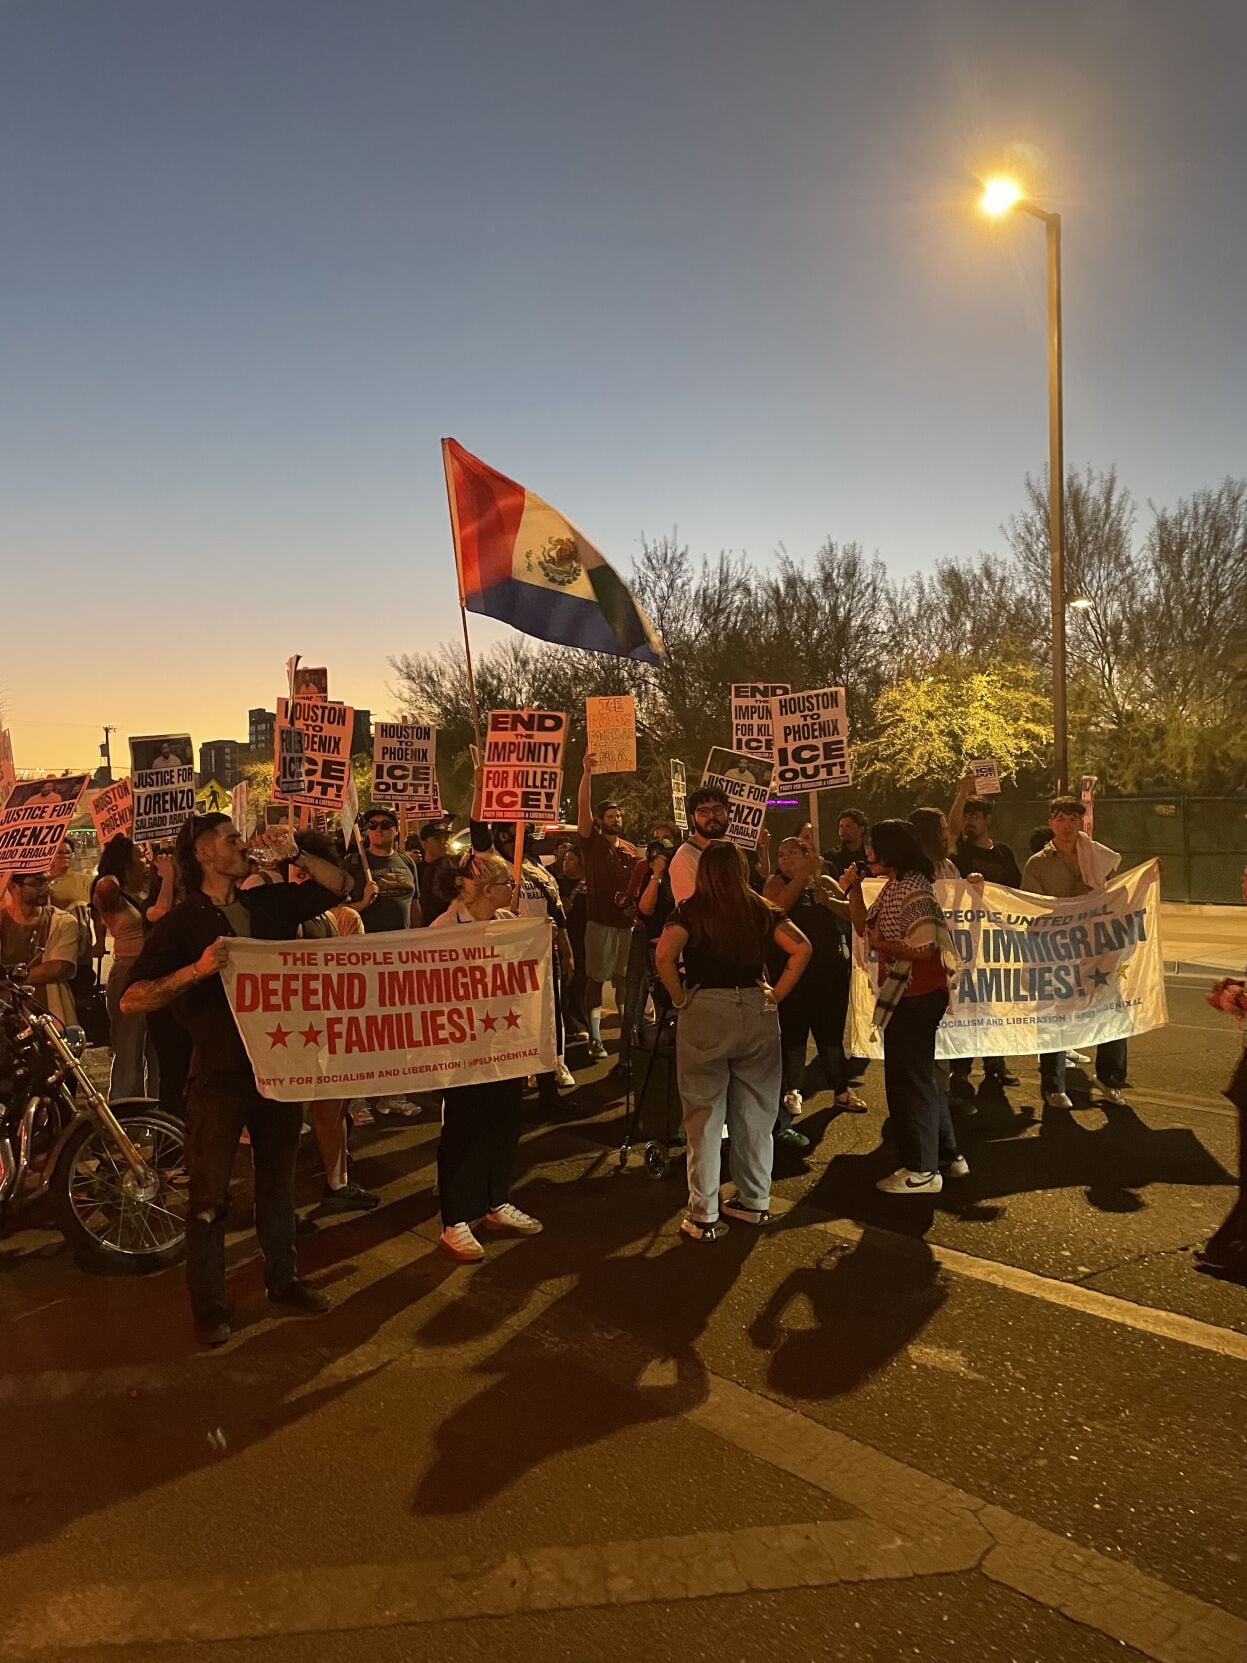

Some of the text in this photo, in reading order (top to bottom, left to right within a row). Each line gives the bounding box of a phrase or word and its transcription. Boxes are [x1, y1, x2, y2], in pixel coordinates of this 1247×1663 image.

[734, 685, 789, 698] END
[599, 698, 624, 714] ICE
[735, 705, 772, 720] IMPUN
[778, 690, 839, 716] HOUSTON
[304, 723, 324, 732] TO
[490, 713, 563, 732] END
[800, 713, 820, 722] TO
[381, 724, 430, 740] HOUSTON
[735, 724, 773, 736] FOR KIL
[783, 719, 840, 744] PHOENIX
[304, 732, 342, 756] OENIX
[382, 746, 428, 762] PHOENIX
[487, 741, 560, 764] IMPUNITY
[778, 740, 844, 767] ICE
[134, 768, 193, 788] JUSTICE FOR
[376, 764, 430, 781] ICE
[486, 770, 558, 789] FOR KILLER
[778, 761, 846, 782] OUT!
[92, 780, 130, 815] HOUSTON
[374, 781, 430, 794] OUT!
[704, 775, 746, 798] JUSTICE
[747, 785, 768, 804] FOR
[107, 803, 119, 814] TO
[136, 788, 194, 817] LORENZO
[485, 790, 555, 810] ICE!
[0, 802, 75, 826] JUSTICE FOR
[135, 816, 168, 830] SALGADO
[728, 802, 762, 827] ENZO
[0, 824, 65, 848] ORENZO
[729, 824, 758, 839] ARAUJO
[19, 846, 56, 858] ARAUJO
[1008, 914, 1074, 926] UNITED
[1078, 904, 1114, 921] WILL
[982, 908, 1146, 963] IMMIGRANT
[279, 946, 499, 966] THE PEOPLE UNITED WILL
[236, 959, 540, 1013] DEFEND IMMIGRANT
[958, 964, 1086, 1003] AMILIES!
[986, 1018, 1004, 1026] AND
[1006, 1014, 1066, 1025] LIBERATION
[326, 1007, 477, 1055] FAMILIES!
[258, 1076, 285, 1086] PARTY
[290, 1076, 313, 1085] FOR
[317, 1071, 375, 1084] SOCIALISM
[378, 1068, 400, 1078] AND
[402, 1061, 461, 1075] LIBERATION
